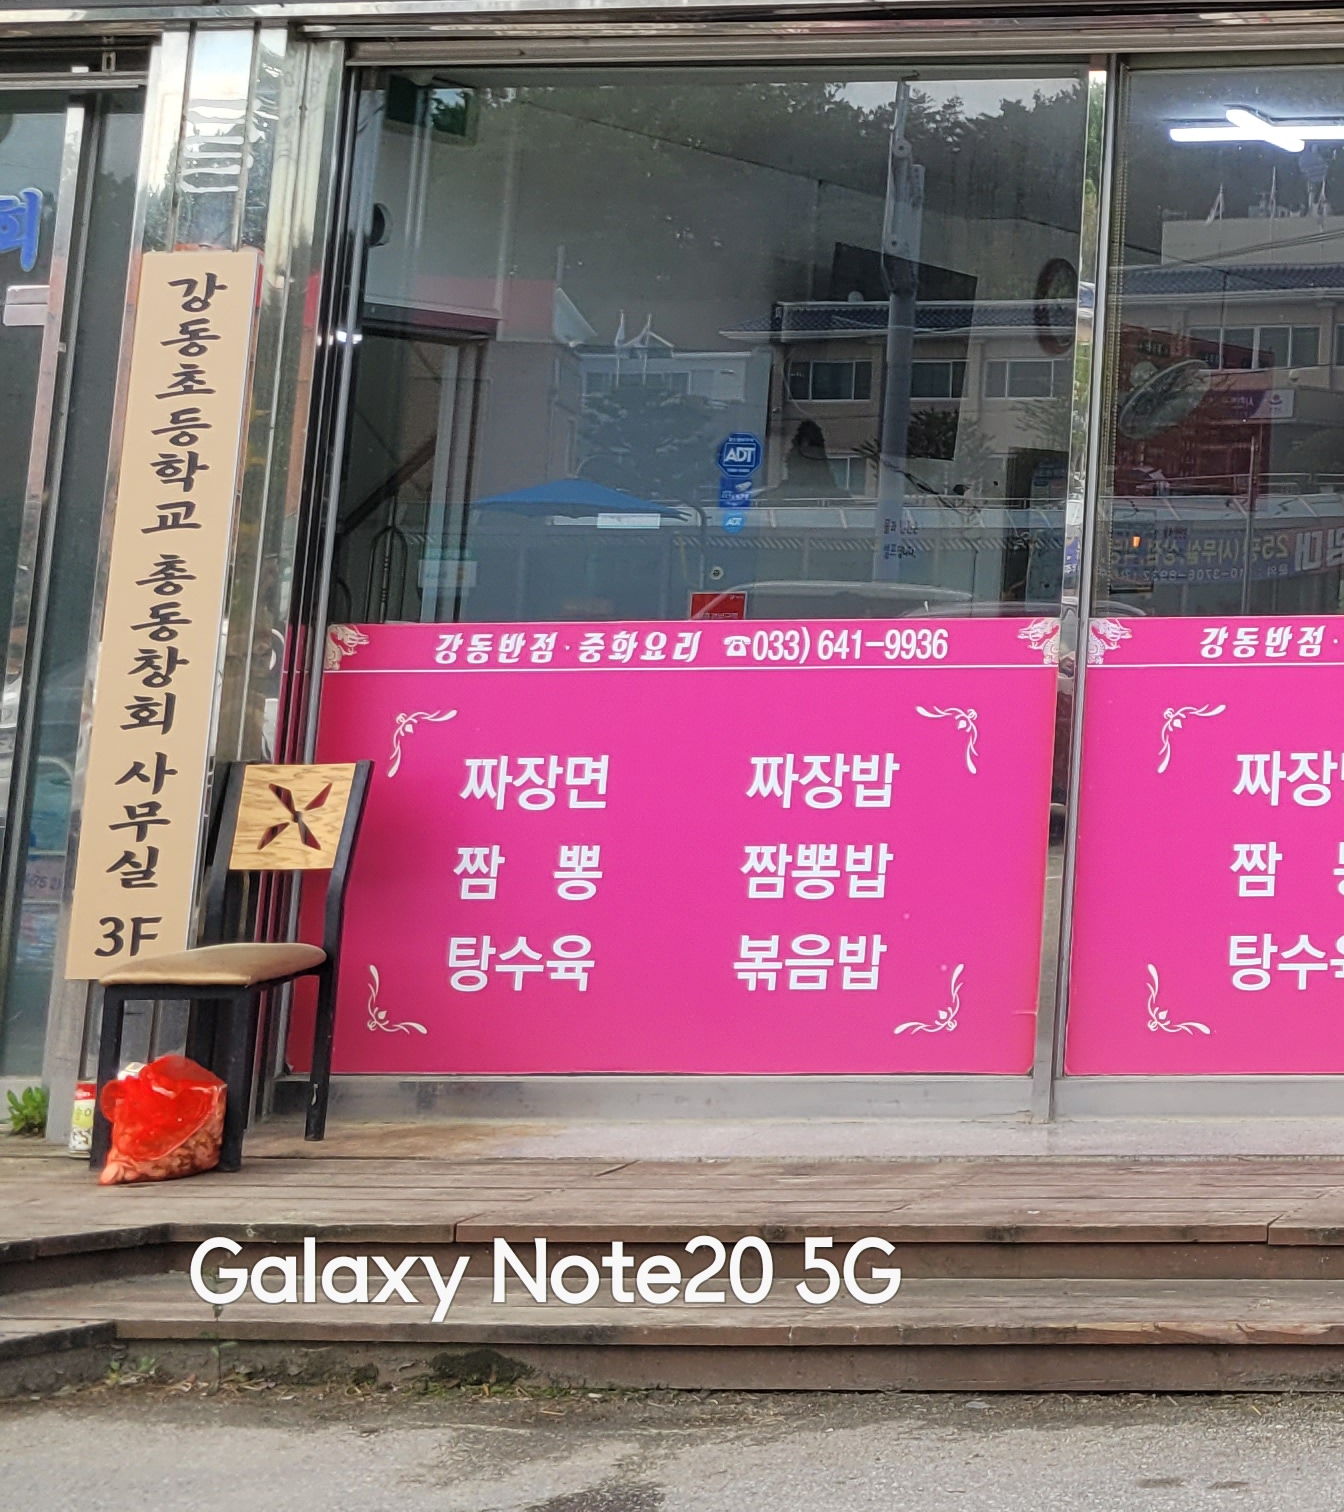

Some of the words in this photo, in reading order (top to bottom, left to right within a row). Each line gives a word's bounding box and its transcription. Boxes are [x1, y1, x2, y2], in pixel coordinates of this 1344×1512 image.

[142, 272, 227, 534] 강동초등학교
[724, 446, 756, 463] ADT
[119, 554, 193, 736] 총동창회
[578, 630, 702, 664] 중화요리
[459, 754, 609, 811] 짜장면
[745, 752, 901, 809] 짜장밥
[105, 751, 178, 889] 사무실
[740, 842, 894, 900] 짬뽕밥
[94, 916, 162, 958] 3F
[448, 934, 595, 993] 탕수육
[733, 933, 888, 992] 볶음밥
